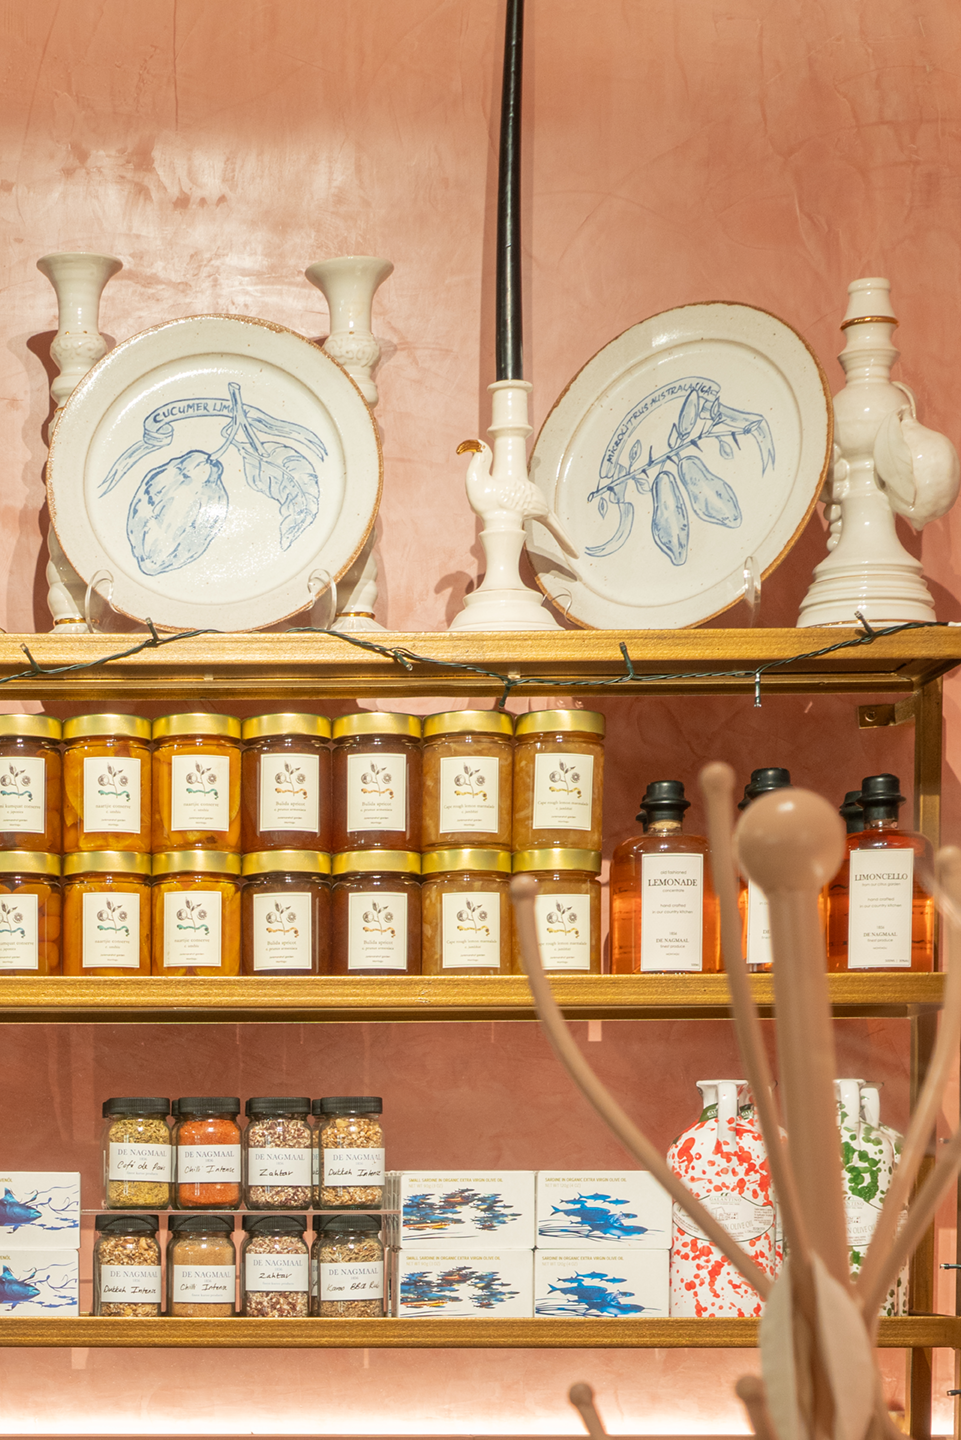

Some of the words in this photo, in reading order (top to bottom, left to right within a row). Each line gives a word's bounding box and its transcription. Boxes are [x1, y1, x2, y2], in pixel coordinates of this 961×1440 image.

[153, 402, 210, 423] CUCUMER
[855, 873, 908, 881] LIMONCELLO
[130, 1149, 167, 1157] NAGMAAL
